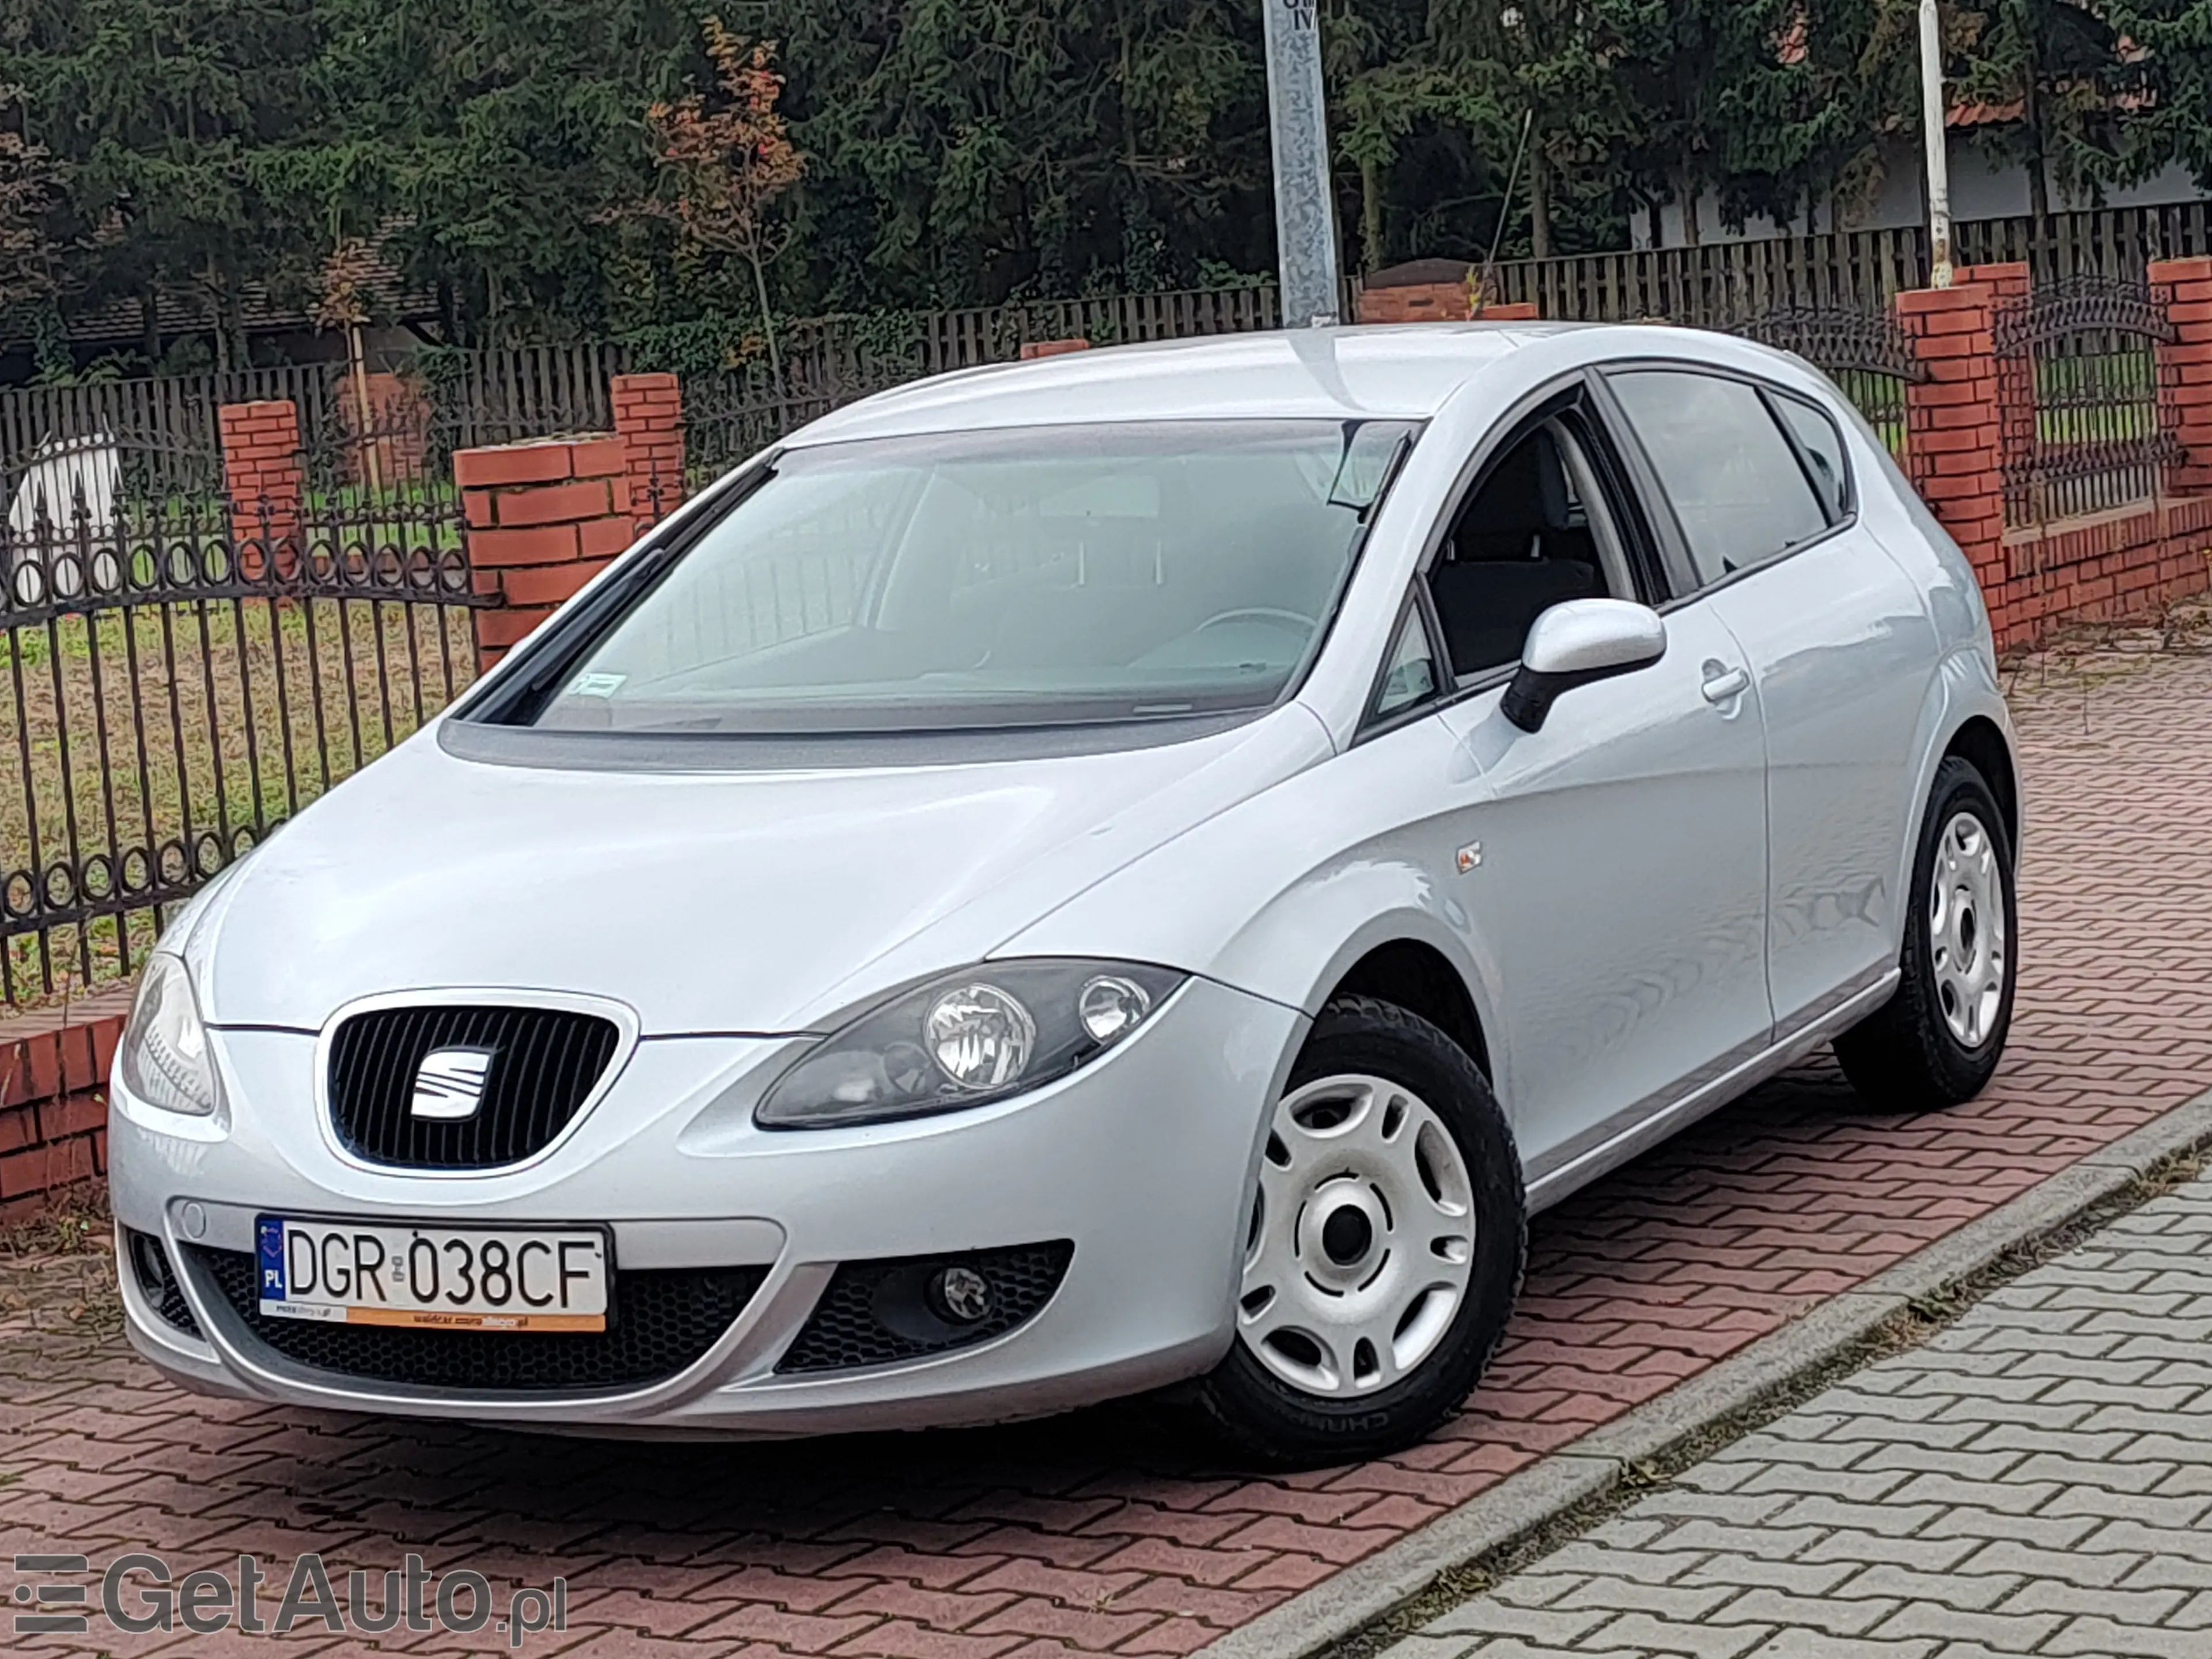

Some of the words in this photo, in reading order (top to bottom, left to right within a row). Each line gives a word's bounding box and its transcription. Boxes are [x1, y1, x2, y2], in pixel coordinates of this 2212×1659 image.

[264, 1269, 283, 1289] PL
[288, 1229, 387, 1301] DGR
[408, 1237, 596, 1308] 038CF
